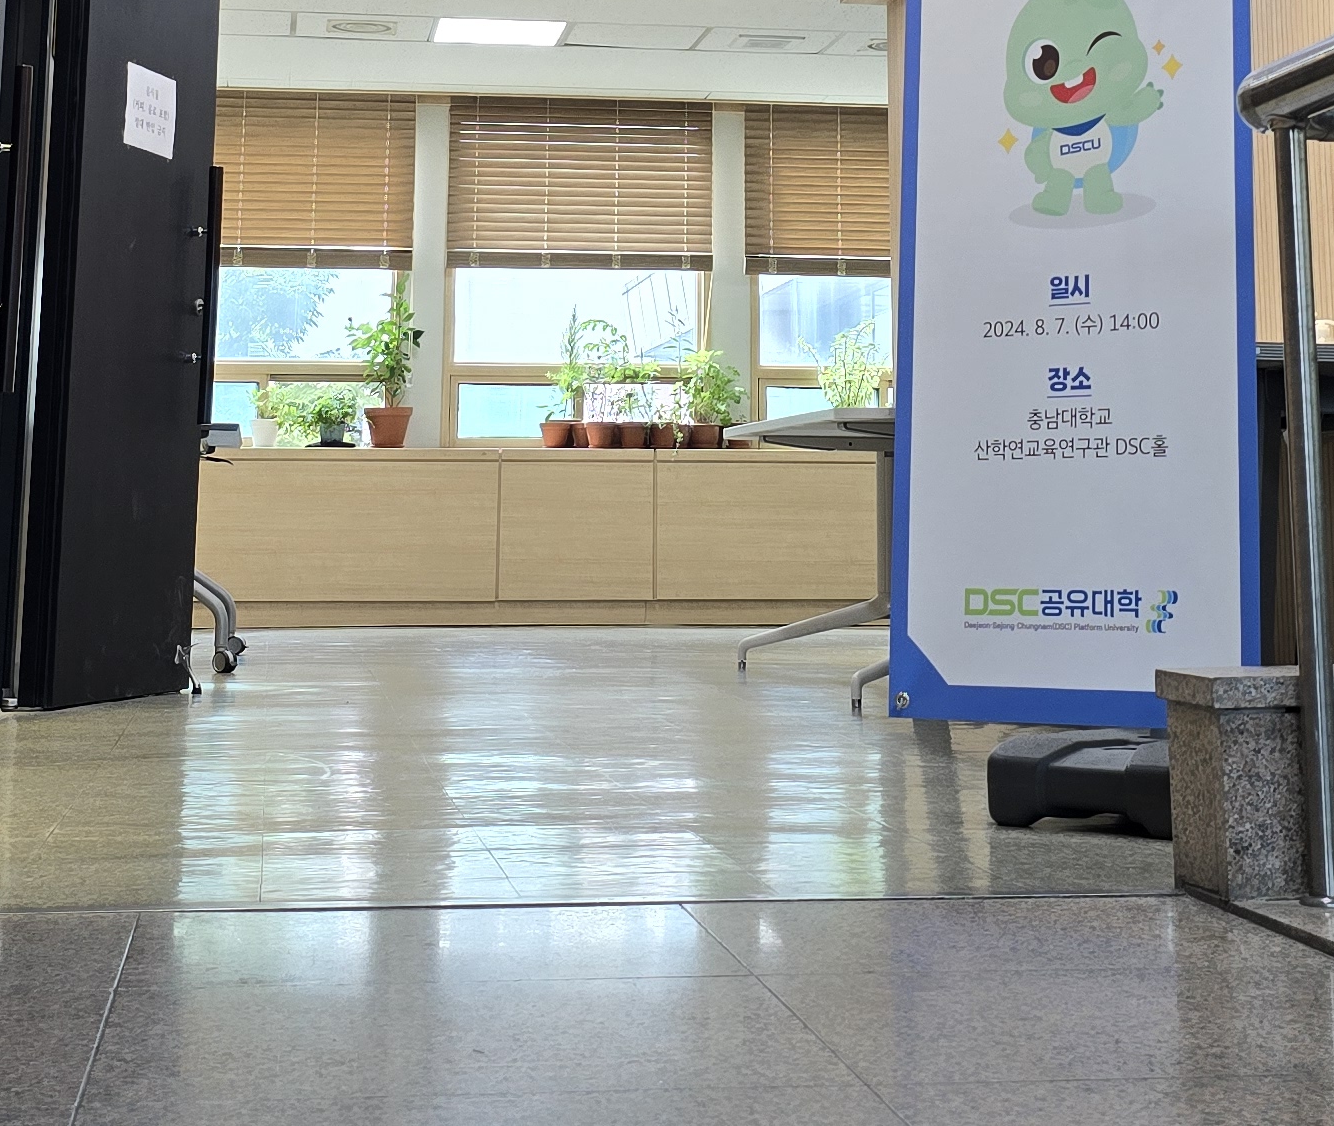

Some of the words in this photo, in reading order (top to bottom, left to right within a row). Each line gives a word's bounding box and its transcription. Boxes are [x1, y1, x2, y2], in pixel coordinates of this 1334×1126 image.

[1059, 138, 1101, 156] DSCU
[1049, 274, 1090, 300] 일시
[983, 320, 1030, 338] 2024.
[1034, 319, 1049, 336] 8.
[1054, 317, 1069, 335] 7.
[1075, 314, 1103, 336] (수)
[1109, 312, 1160, 332] 14:00
[1047, 366, 1092, 392] 장소
[1027, 407, 1113, 431] 충남대학교
[973, 436, 1110, 461] 산학연교육연구관
[1115, 435, 1169, 458] DSC홀
